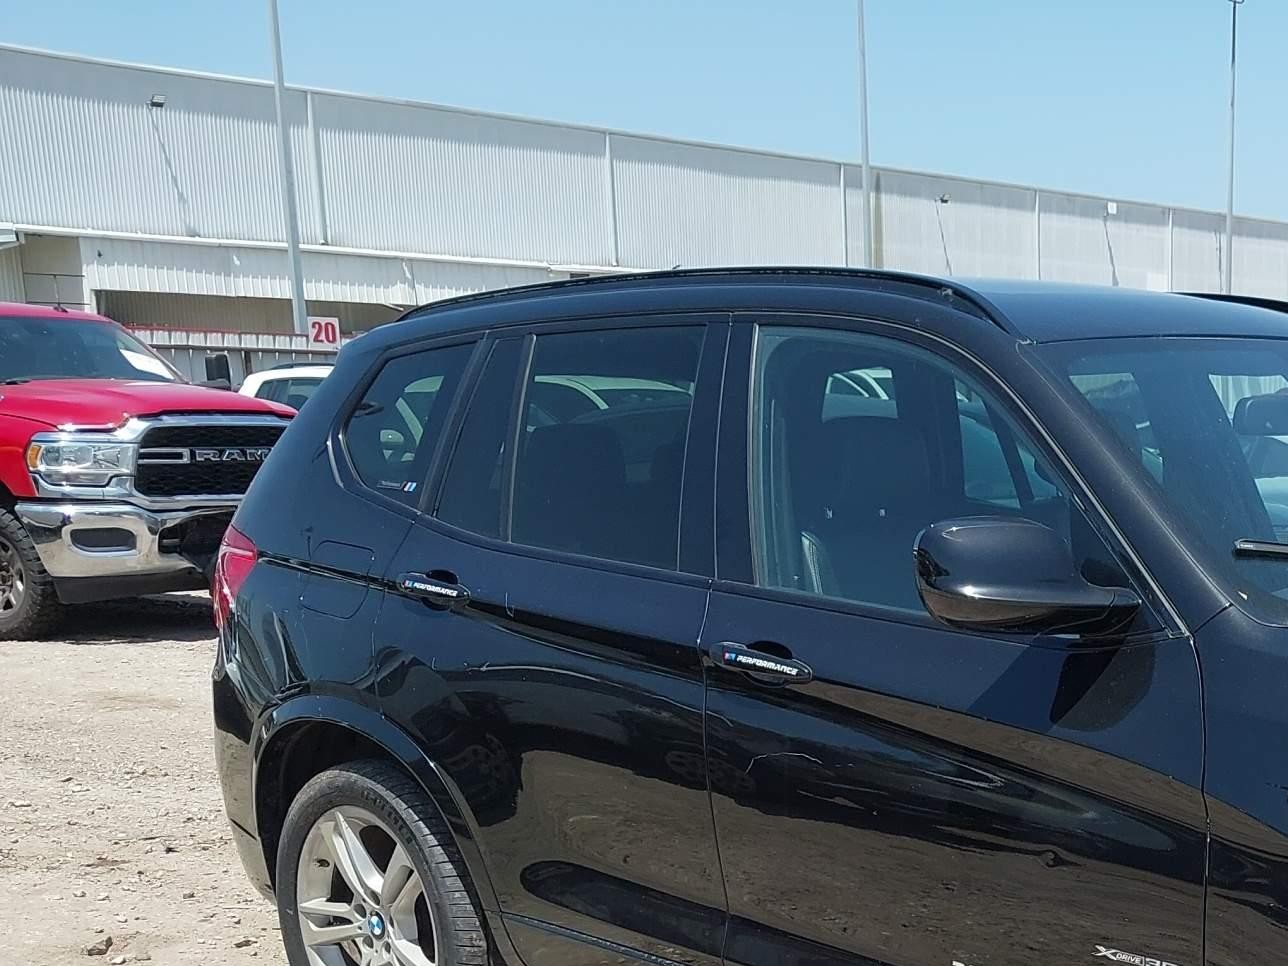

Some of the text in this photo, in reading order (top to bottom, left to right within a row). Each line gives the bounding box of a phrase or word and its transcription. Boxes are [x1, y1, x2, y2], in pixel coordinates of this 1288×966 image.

[311, 321, 337, 344] 20
[413, 582, 458, 597] PERFORMANCE
[736, 655, 799, 676] PERFORMANCE
